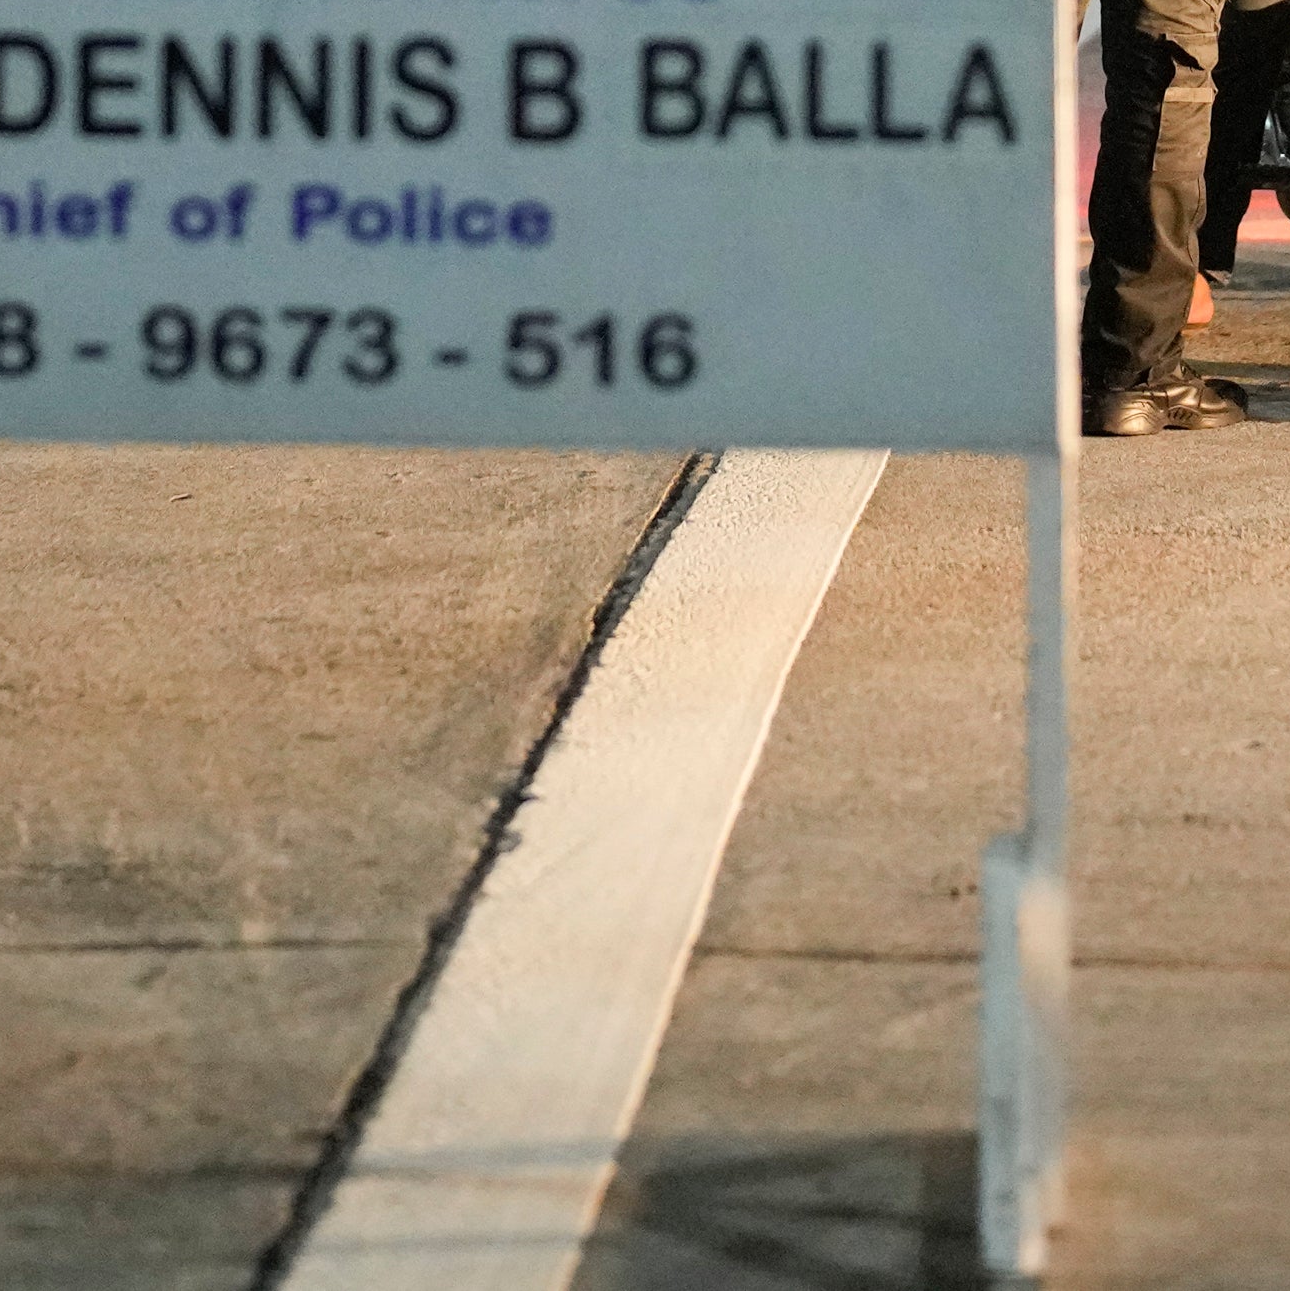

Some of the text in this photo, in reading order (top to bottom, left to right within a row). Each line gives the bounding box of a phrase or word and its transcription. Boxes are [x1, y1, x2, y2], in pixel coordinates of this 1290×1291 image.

[505, 38, 585, 146] B
[637, 38, 1018, 145] BALLA
[167, 182, 256, 245] of
[289, 182, 555, 249] Police
[138, 304, 402, 387] 9673
[503, 310, 700, 391] 516
